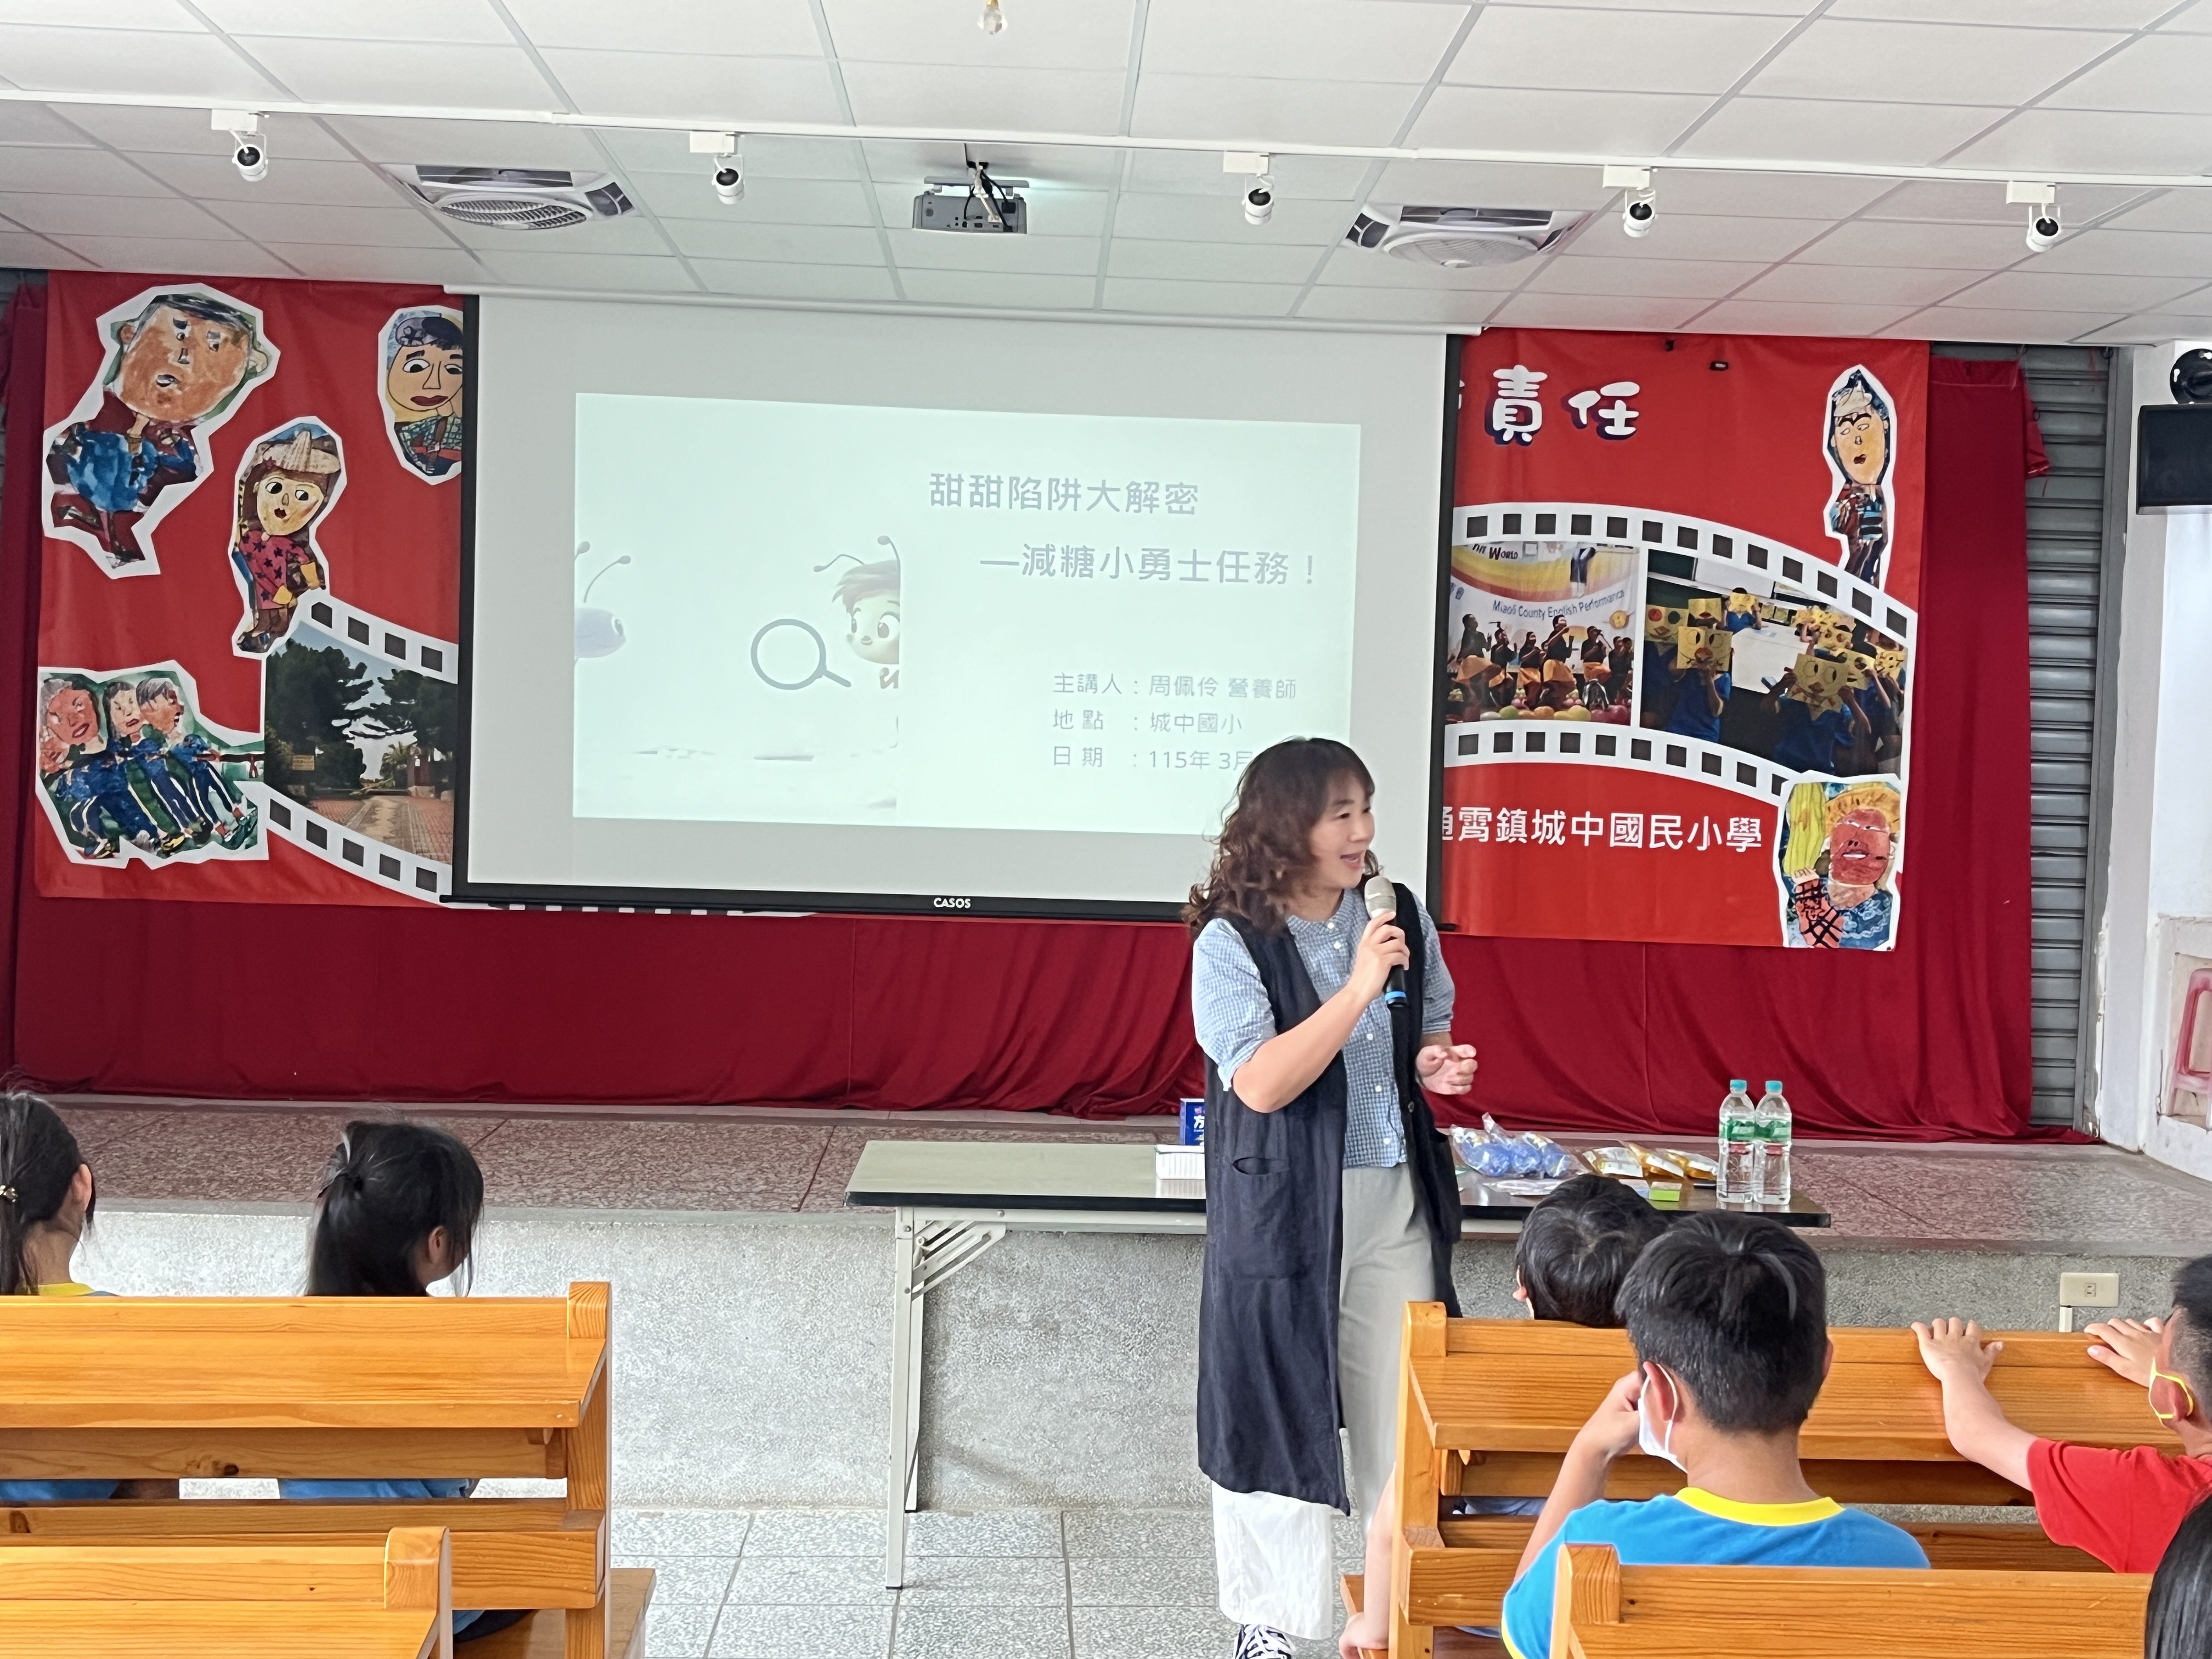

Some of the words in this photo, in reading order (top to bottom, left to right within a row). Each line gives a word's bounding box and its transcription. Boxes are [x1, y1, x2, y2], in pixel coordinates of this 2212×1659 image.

[1458, 364, 1640, 442] 責任
[929, 473, 1198, 515] 甜甜陷阱大解密
[1519, 605, 1546, 621] County
[1228, 678, 1296, 699] 營養師
[933, 897, 971, 909] CASOS
